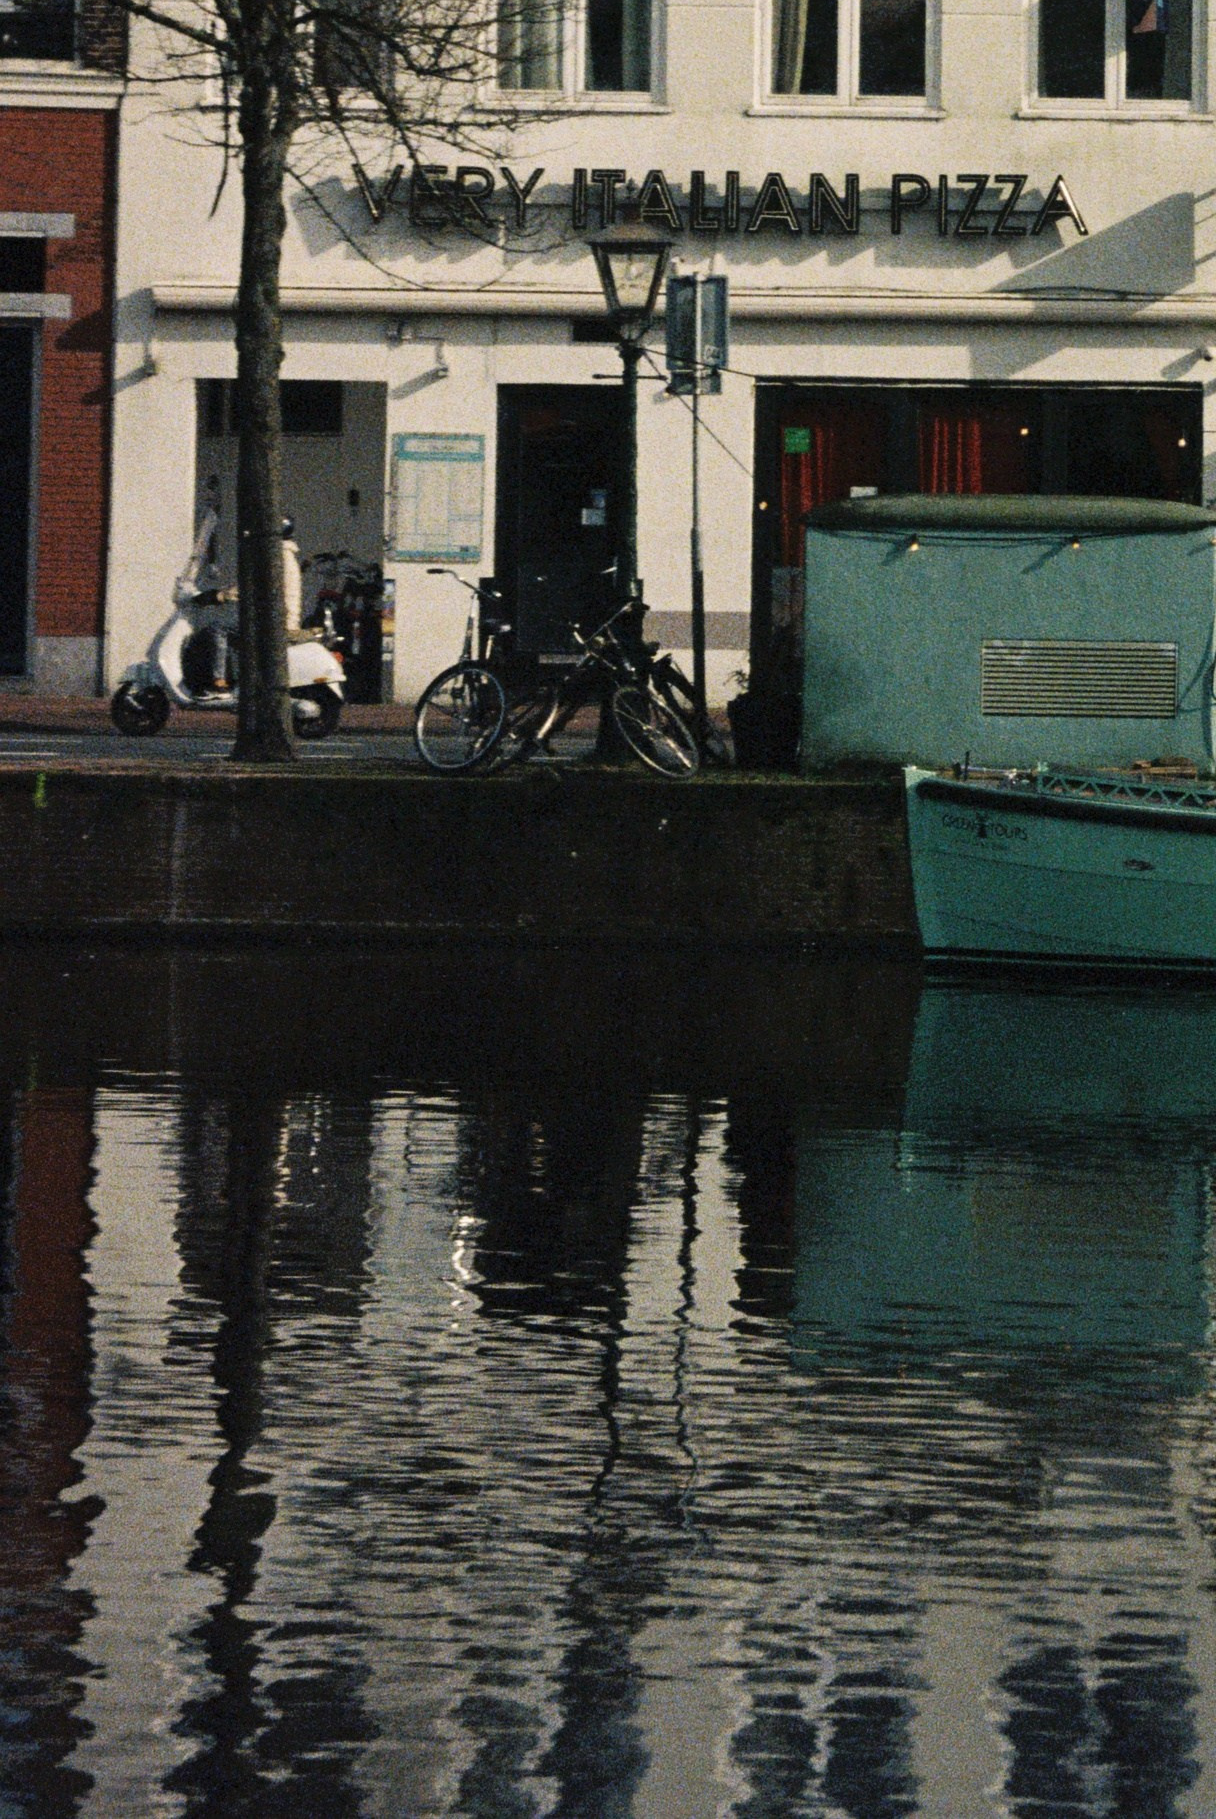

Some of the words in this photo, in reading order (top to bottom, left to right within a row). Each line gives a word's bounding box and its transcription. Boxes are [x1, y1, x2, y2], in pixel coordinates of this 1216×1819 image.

[352, 164, 545, 228] VERY
[572, 168, 860, 232] ITALIAN
[891, 173, 1089, 235] PIZZA
